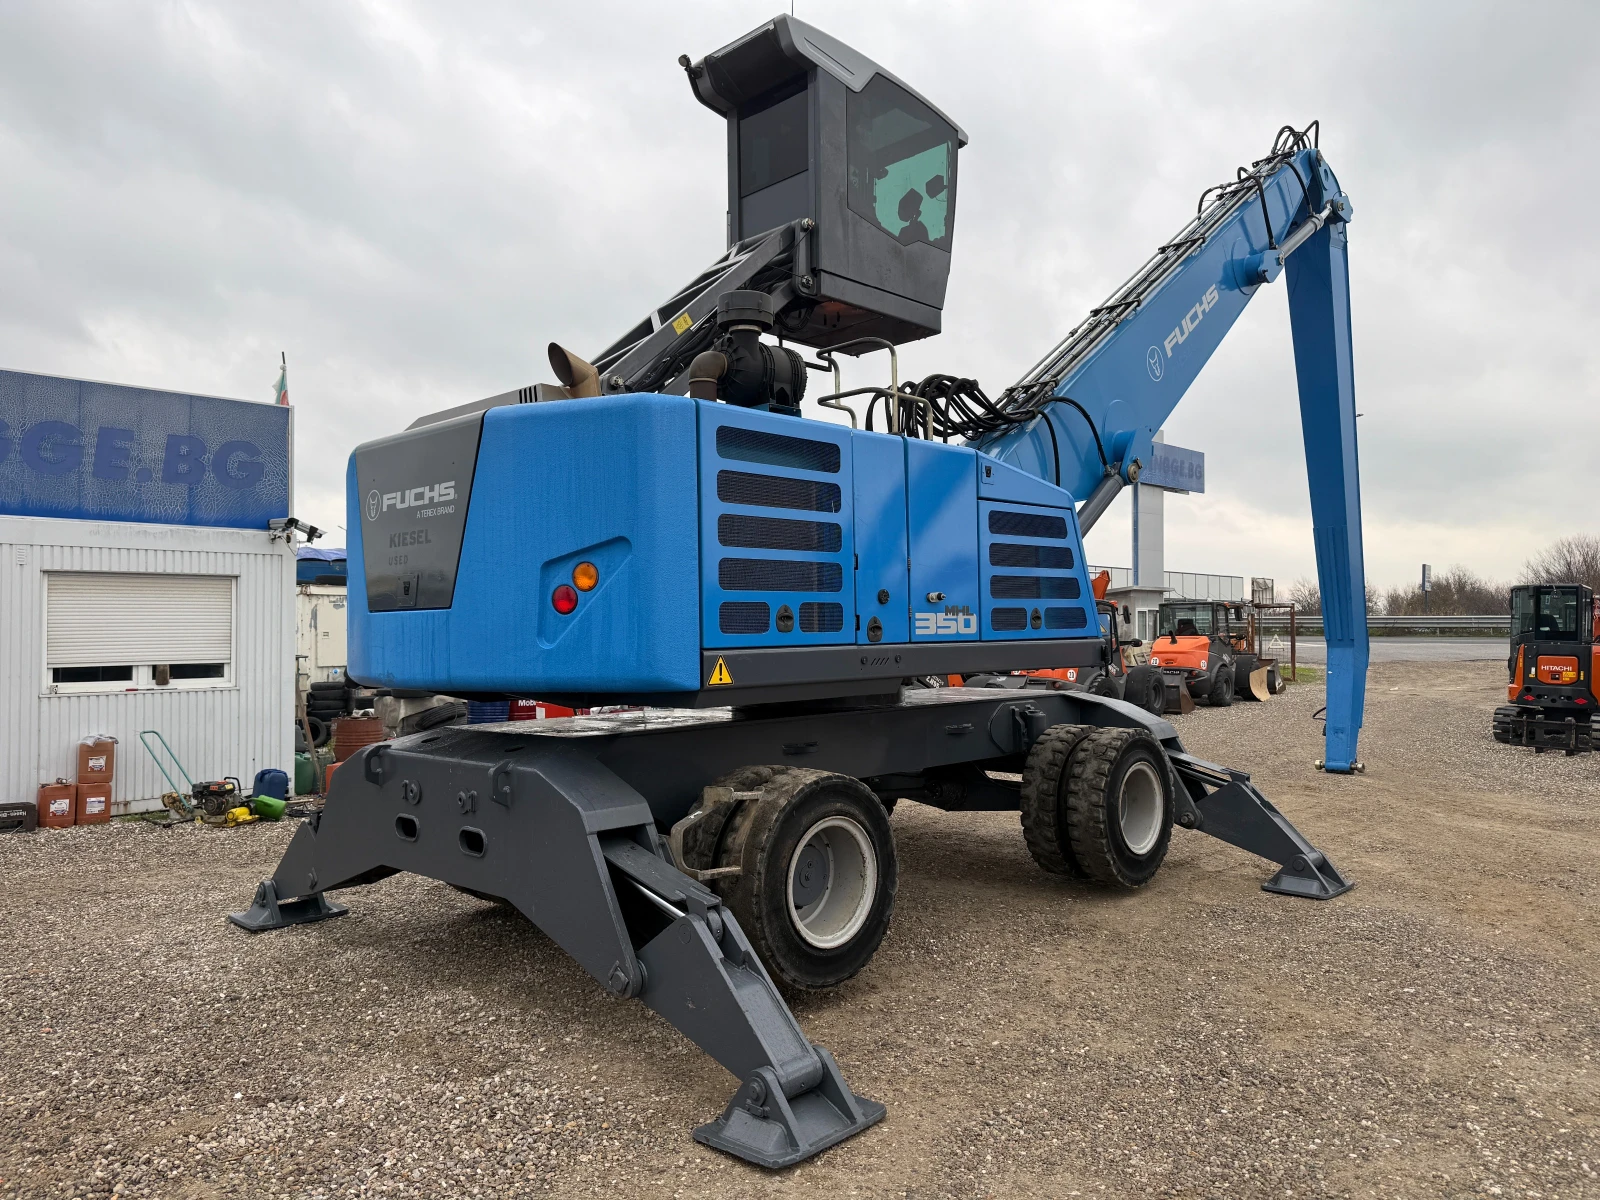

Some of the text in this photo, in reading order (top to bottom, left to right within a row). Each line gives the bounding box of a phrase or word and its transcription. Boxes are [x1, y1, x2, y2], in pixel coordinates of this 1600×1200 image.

[1163, 283, 1219, 358] FUCHS
[0, 419, 264, 490] GE.BG
[382, 481, 455, 512] FUCHS
[421, 507, 437, 518] TEREX
[437, 504, 455, 516] BRAND
[389, 529, 432, 548] KIESEL
[388, 555, 409, 566] USED
[945, 605, 975, 616] MHL
[915, 612, 977, 635] 350
